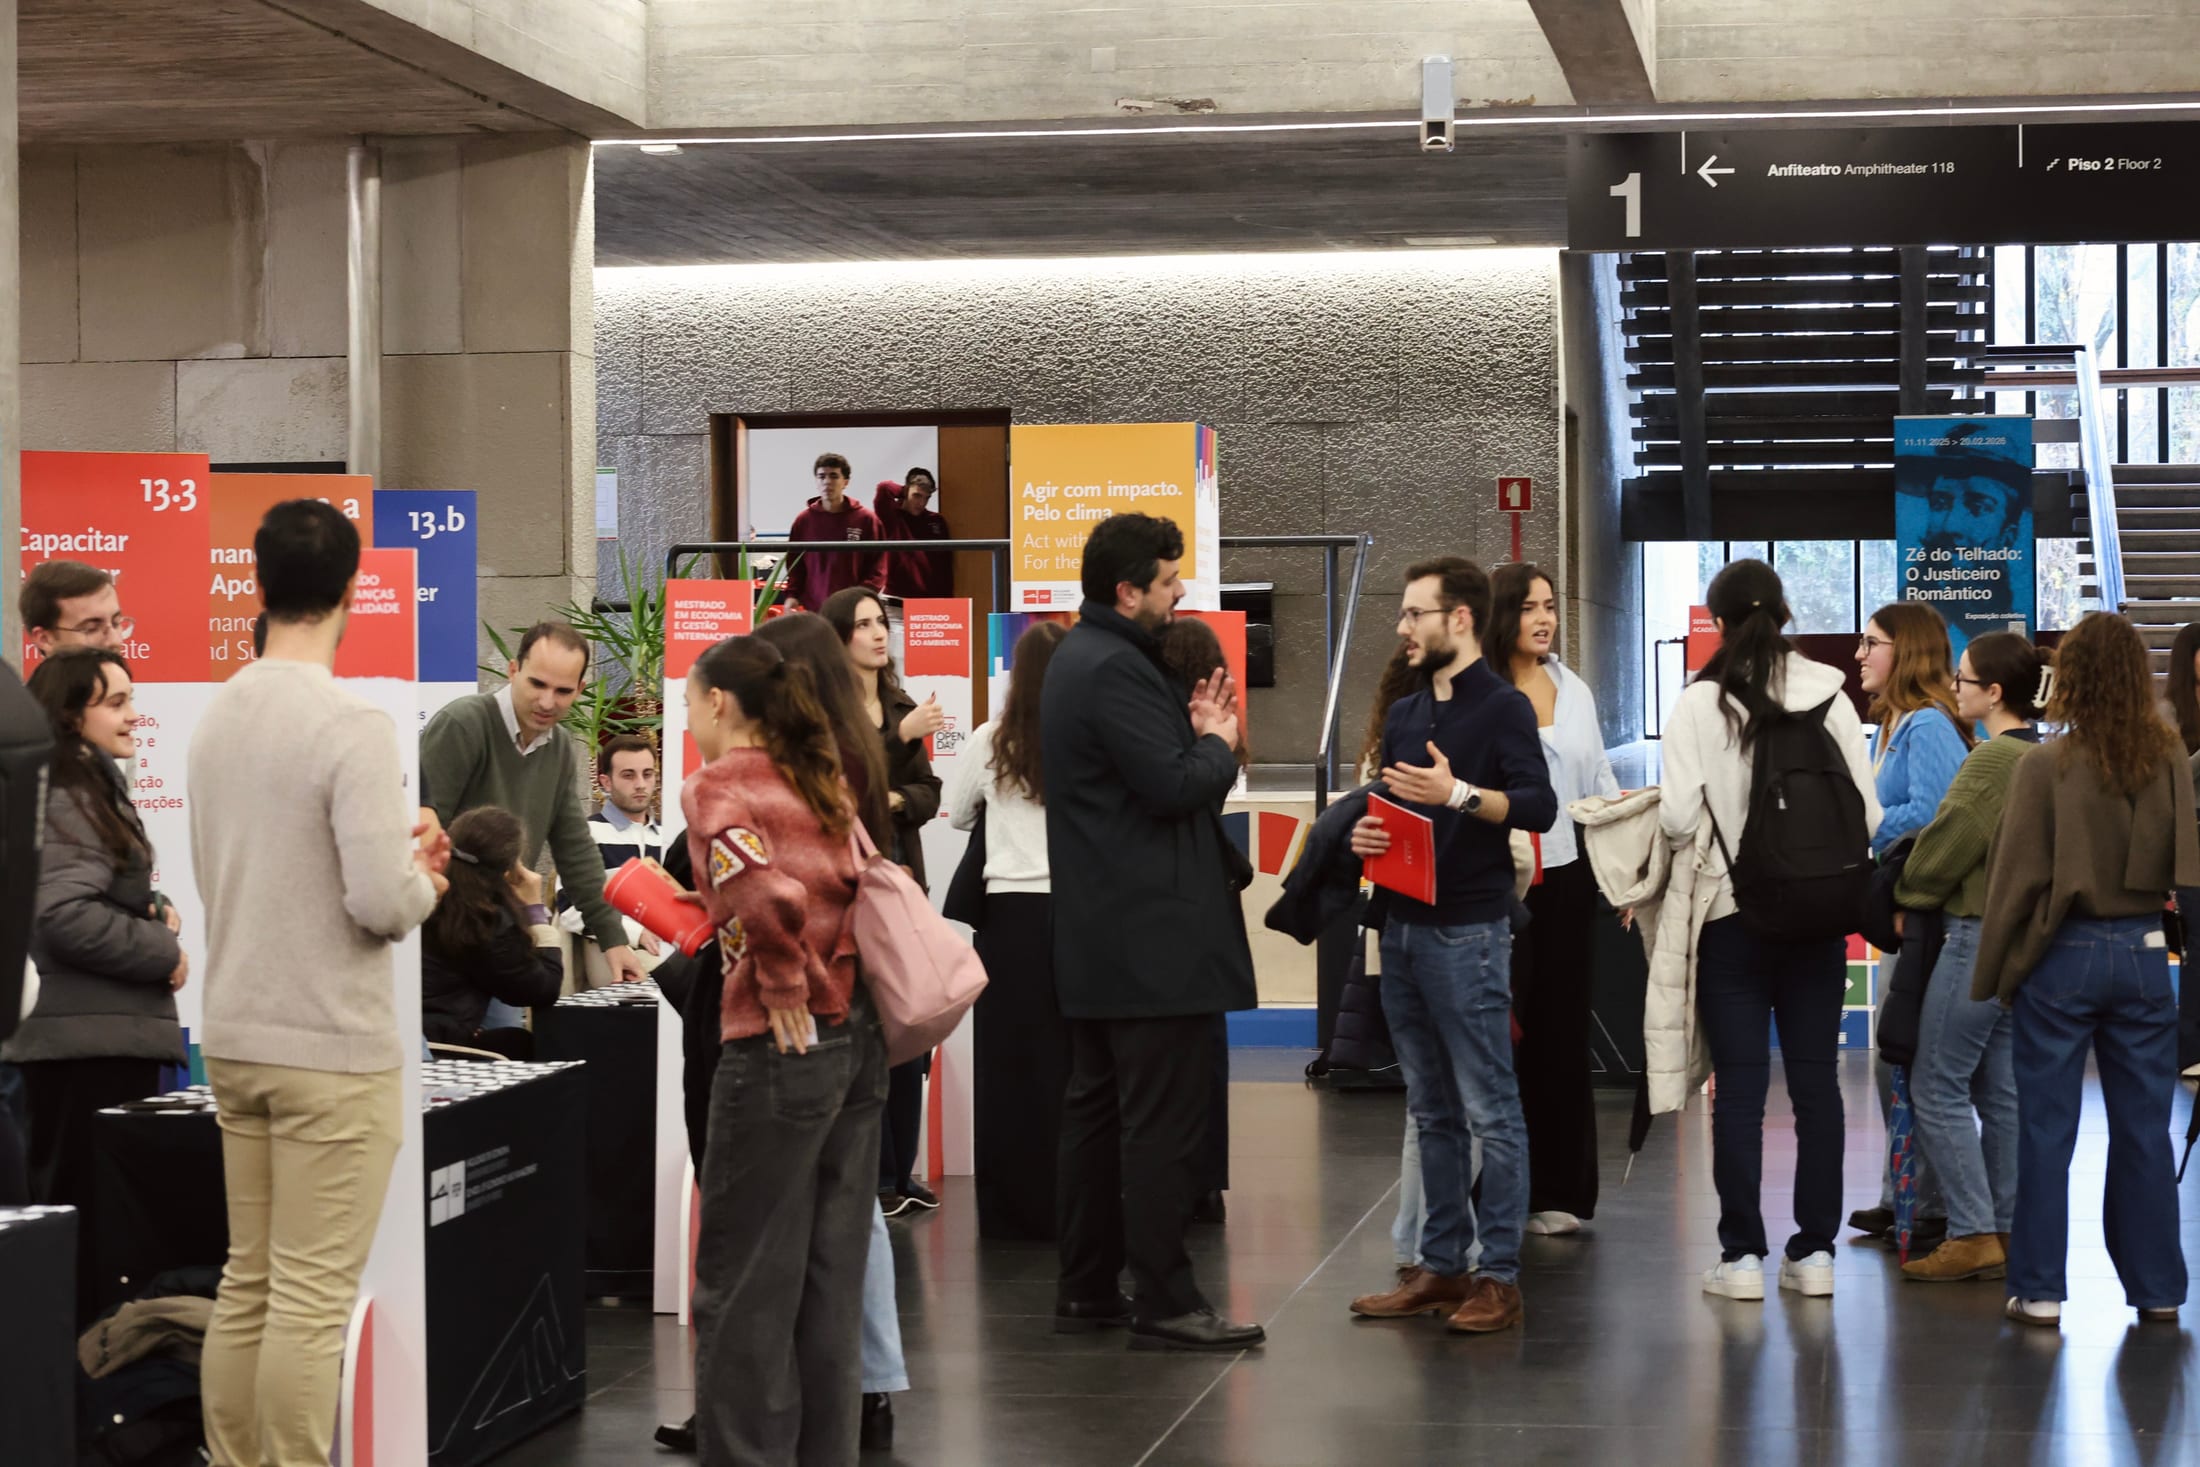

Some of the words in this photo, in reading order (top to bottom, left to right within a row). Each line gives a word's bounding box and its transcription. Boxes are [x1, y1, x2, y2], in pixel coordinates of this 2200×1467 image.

[1767, 163, 1842, 177] Anfiteatro
[1844, 163, 1929, 178] Amphitheater
[1931, 161, 1956, 174] 118
[2068, 158, 2101, 171] Piso
[2104, 157, 2115, 170] 2
[2118, 158, 2151, 170] Floor
[2153, 157, 2162, 170] 2
[1609, 172, 1641, 238] 1
[139, 478, 198, 512] 13.3
[1022, 481, 1058, 503] Agir
[1063, 484, 1101, 498] com
[1107, 480, 1183, 502] impacto.
[1023, 504, 1061, 521] Pelo
[408, 505, 466, 540] 13.b
[1022, 533, 1050, 548] Act
[1023, 554, 1050, 570] For
[1055, 553, 1081, 570] the
[1905, 547, 1927, 562] Zé
[1930, 547, 1952, 561] do
[1955, 546, 2023, 561] Telhado:
[1905, 566, 1920, 581] O
[1922, 566, 2001, 581] Justiceiro
[1906, 585, 1993, 601] Romântico
[674, 600, 726, 610] MESTRADO
[674, 611, 689, 620] EM
[690, 611, 743, 621] ECONOMIA
[909, 614, 950, 622] MESTRADO
[674, 622, 681, 630] E
[682, 620, 719, 631] GESTÃO
[936, 732, 965, 741] OPEN
[936, 741, 956, 750] DAY
